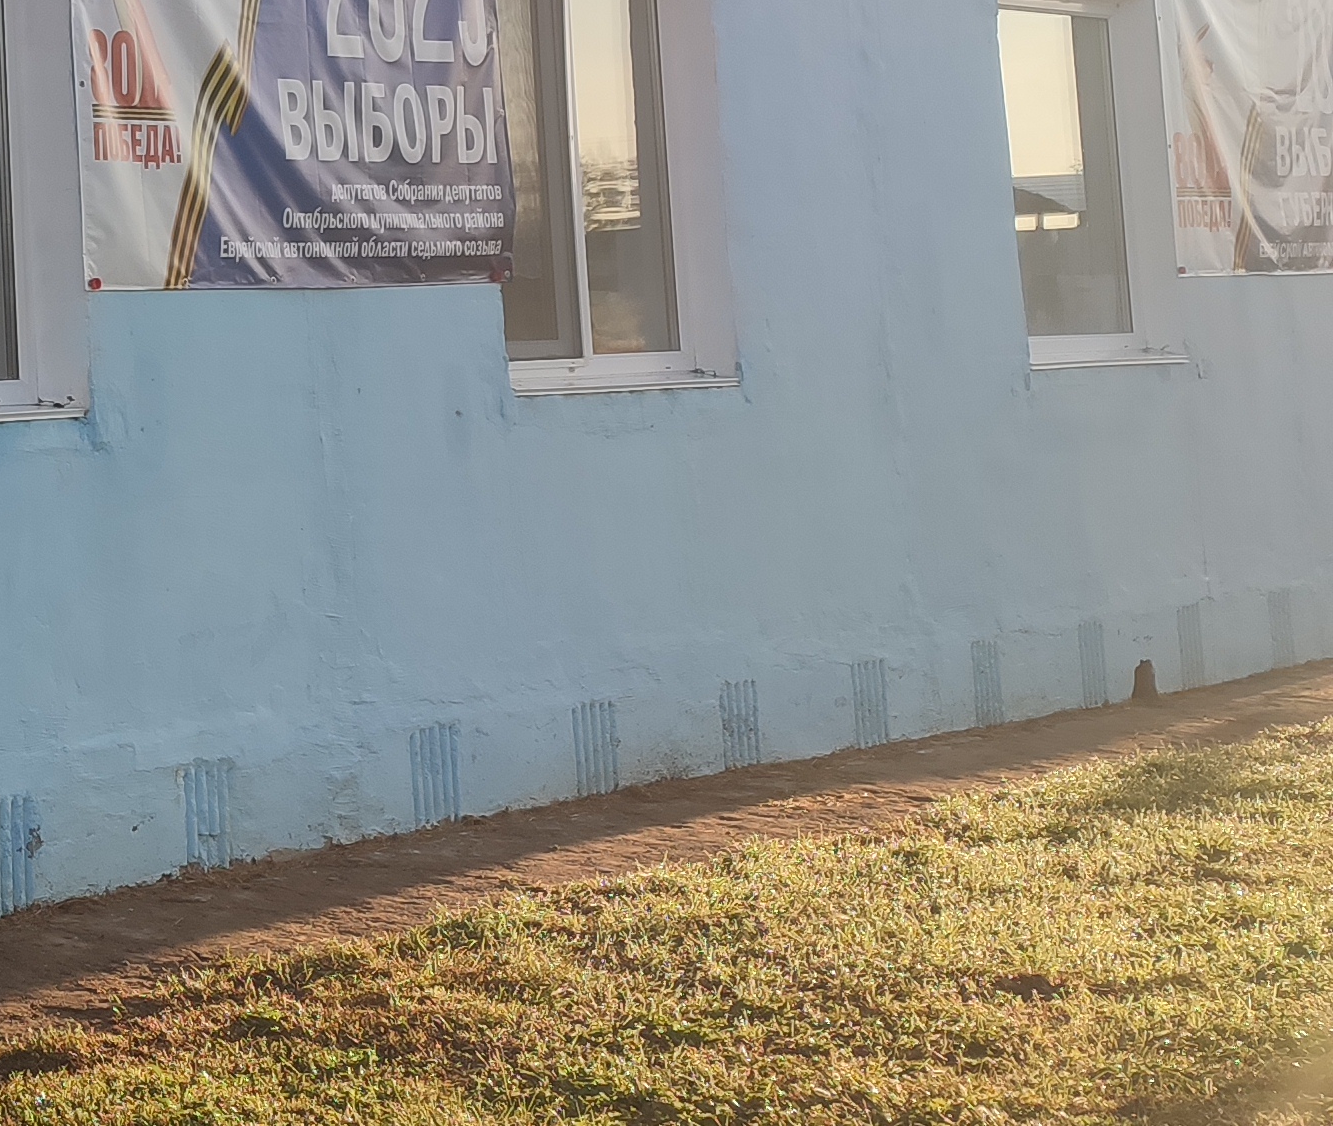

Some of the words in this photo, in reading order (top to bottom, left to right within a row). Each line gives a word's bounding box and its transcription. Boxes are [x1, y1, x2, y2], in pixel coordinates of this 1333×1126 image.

[277, 78, 499, 165] ВЫБОРЫ
[93, 121, 182, 171] ПОБЕДА!
[1275, 126, 1333, 177] ВЫБ
[331, 182, 387, 205] депутатов
[388, 179, 444, 205] Собрания
[445, 182, 503, 205] депутатов
[282, 206, 369, 233] Октябрьского
[370, 211, 462, 233] муниципального
[465, 208, 504, 232] района
[1178, 199, 1232, 233] ПОБЕДА!
[219, 235, 282, 262] Еврейской
[283, 236, 359, 259] автономной
[361, 237, 409, 258] области
[411, 239, 463, 260] седьмого
[464, 237, 503, 257] созыва
